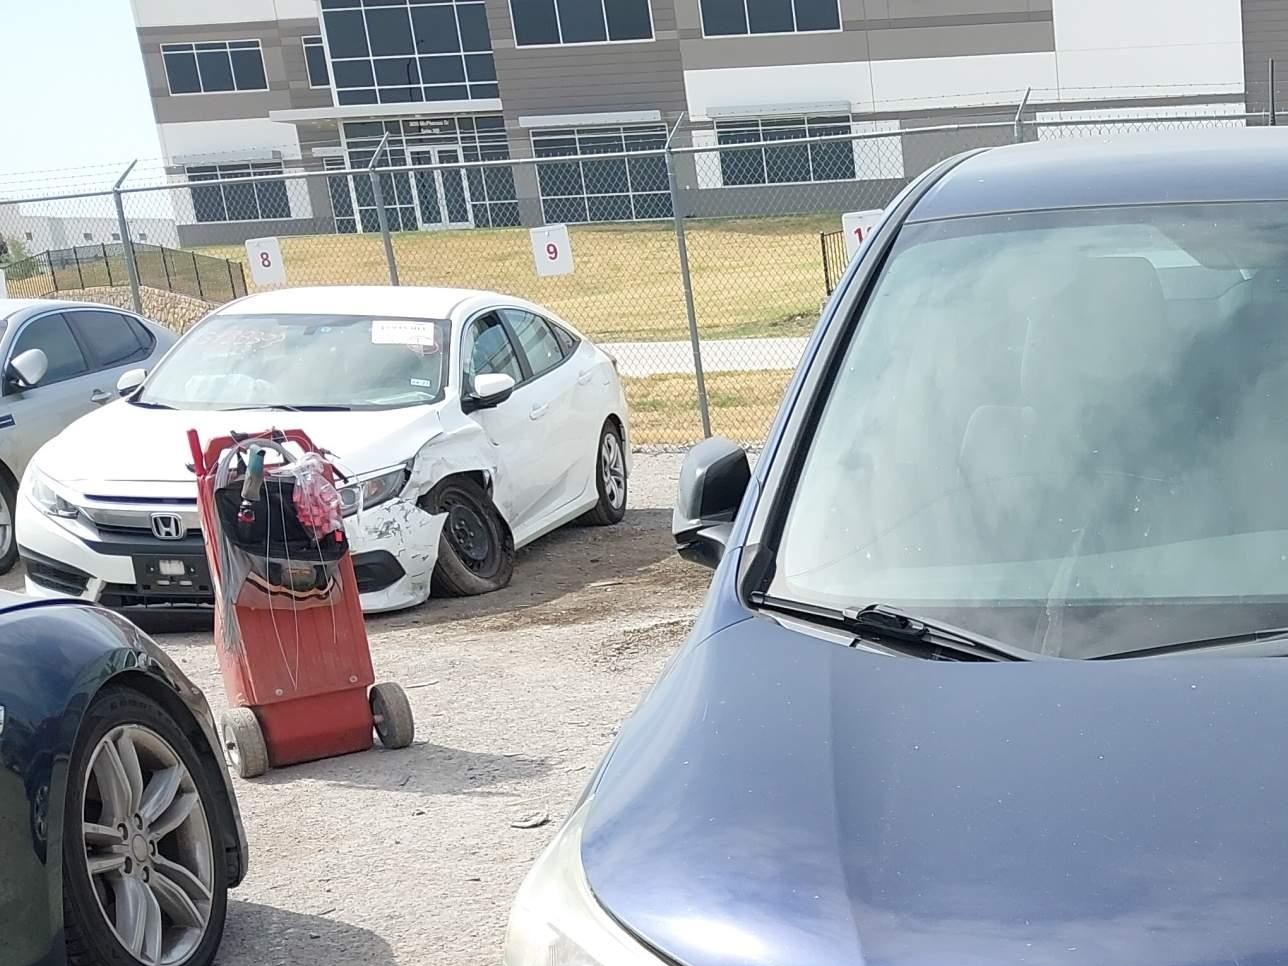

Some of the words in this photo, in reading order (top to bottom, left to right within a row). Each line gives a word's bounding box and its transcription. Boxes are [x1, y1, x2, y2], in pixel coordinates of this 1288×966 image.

[854, 226, 872, 244] 1
[260, 252, 272, 268] 8
[546, 243, 558, 260] 9
